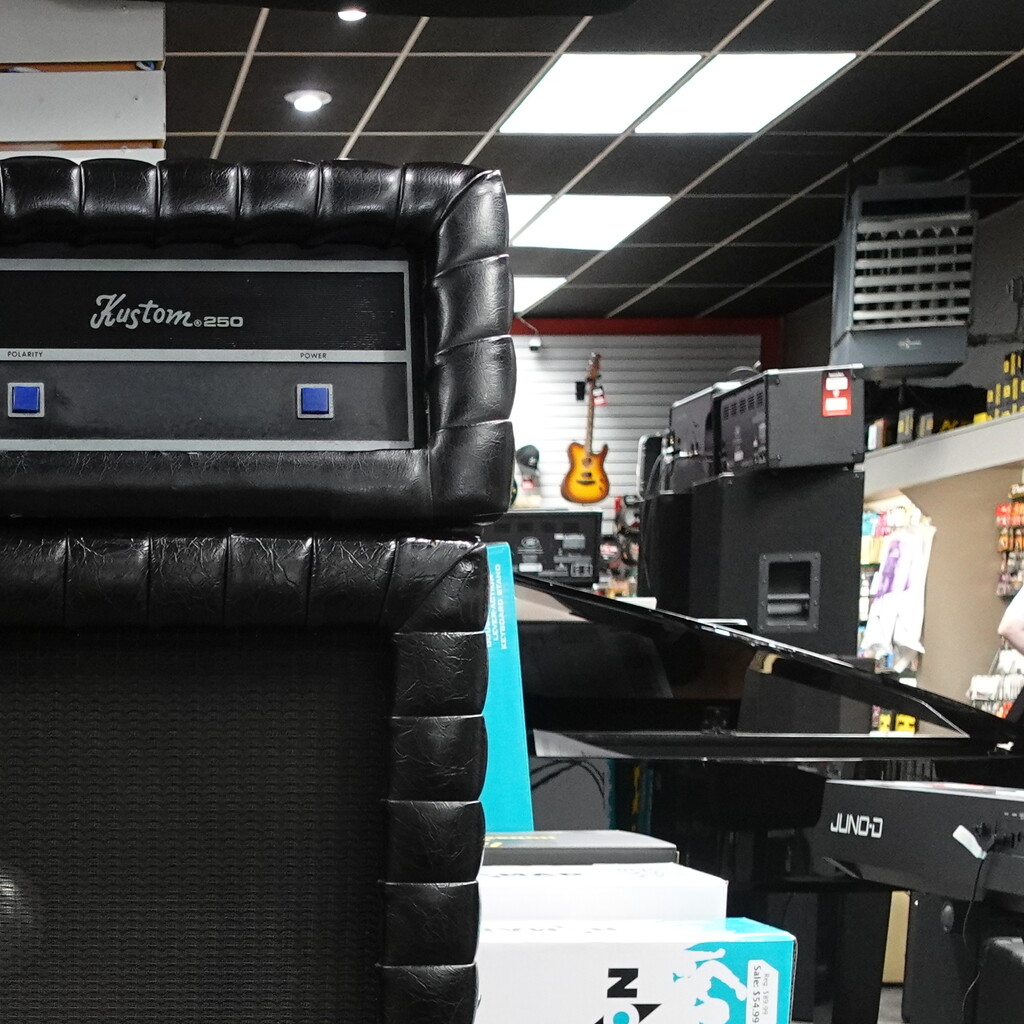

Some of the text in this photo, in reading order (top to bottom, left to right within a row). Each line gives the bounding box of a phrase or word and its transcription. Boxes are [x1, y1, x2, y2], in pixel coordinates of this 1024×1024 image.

[203, 316, 244, 328] 250
[7, 350, 43, 358] POLARITY
[494, 563, 507, 650] KEYBOARD STAND
[830, 812, 884, 839] JUNO-D
[752, 965, 762, 1024] Sale: $54.99
